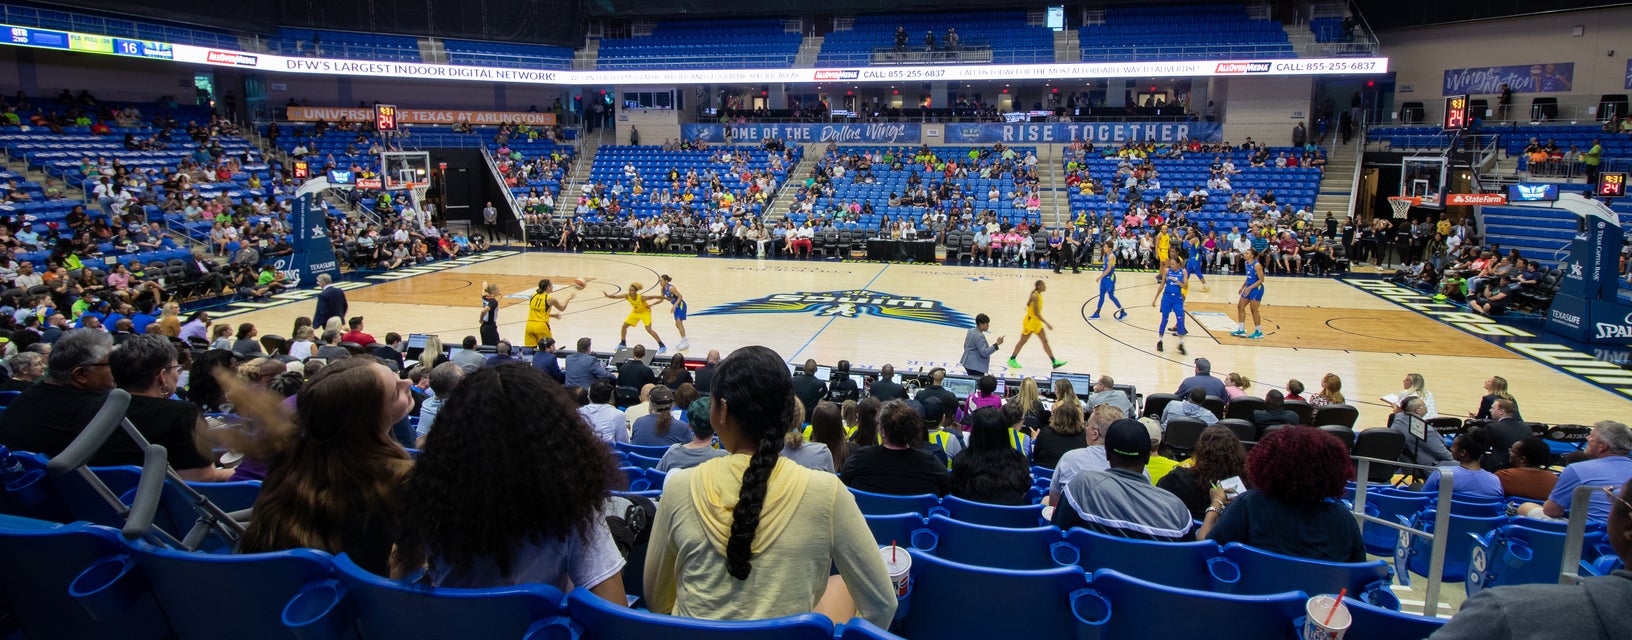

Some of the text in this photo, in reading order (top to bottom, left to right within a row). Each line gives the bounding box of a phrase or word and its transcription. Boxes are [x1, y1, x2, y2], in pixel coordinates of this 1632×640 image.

[122, 42, 137, 54] 16
[287, 60, 556, 80] DFW'S LARGEST INDOOR DIGITAL NETWORK!
[1276, 61, 1376, 71] CALL: 855-255-6837
[864, 69, 946, 78] CALL: 855-255-6837
[1452, 99, 1465, 109] 9:31
[303, 109, 544, 123] UNIVERSIT OF TEXAS AT ARLINGTON
[380, 107, 393, 115] 9:31
[380, 115, 393, 128] 24
[1450, 110, 1464, 127] 24
[764, 128, 778, 139] OF
[785, 128, 810, 139] THE
[820, 125, 861, 142] Dallas
[866, 123, 905, 143] Wings
[1003, 125, 1189, 141] RISE TOGETHER
[1605, 175, 1622, 184] 9:31
[1604, 183, 1619, 194] 24
[535, 298, 542, 308] 11
[1552, 309, 1580, 325] TEXASLIFE
